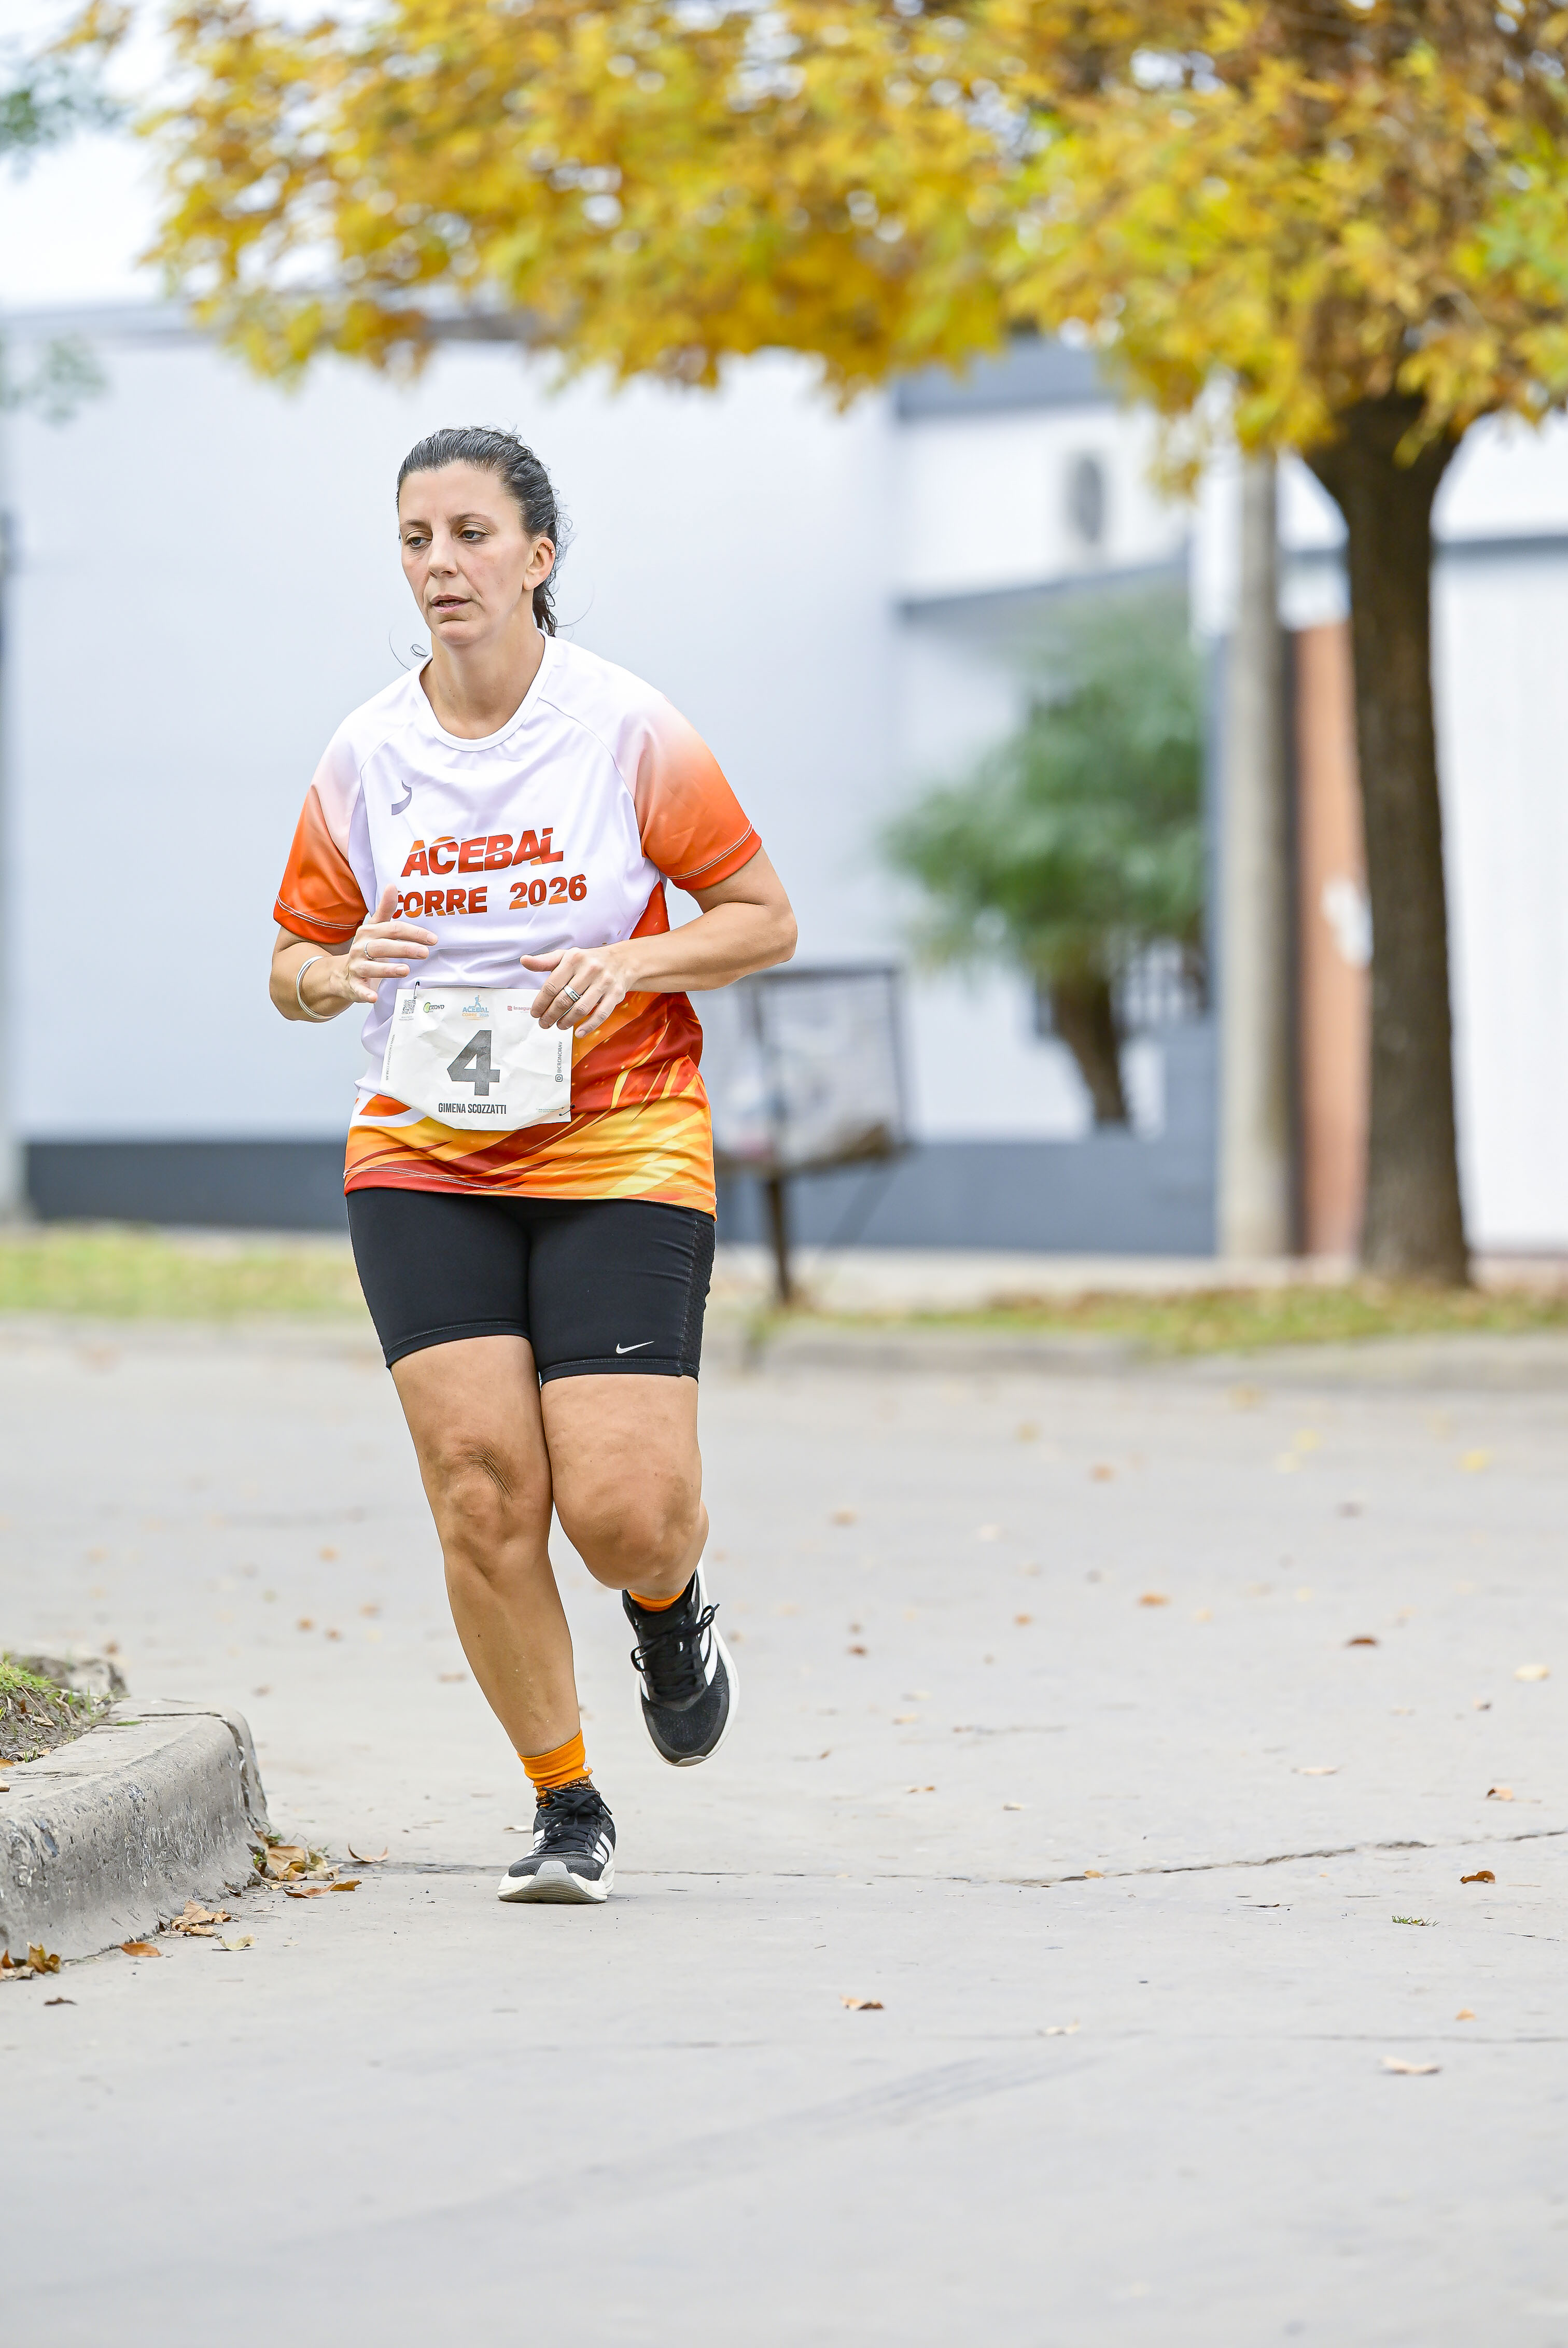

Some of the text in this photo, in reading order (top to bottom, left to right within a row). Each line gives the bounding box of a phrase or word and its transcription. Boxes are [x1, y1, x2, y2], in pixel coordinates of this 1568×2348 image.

[401, 828, 564, 877] ACEBAL
[509, 874, 587, 910] 2026
[446, 1030, 500, 1096] 4
[438, 1102, 507, 1115] GIMENA SCOZZATTI
